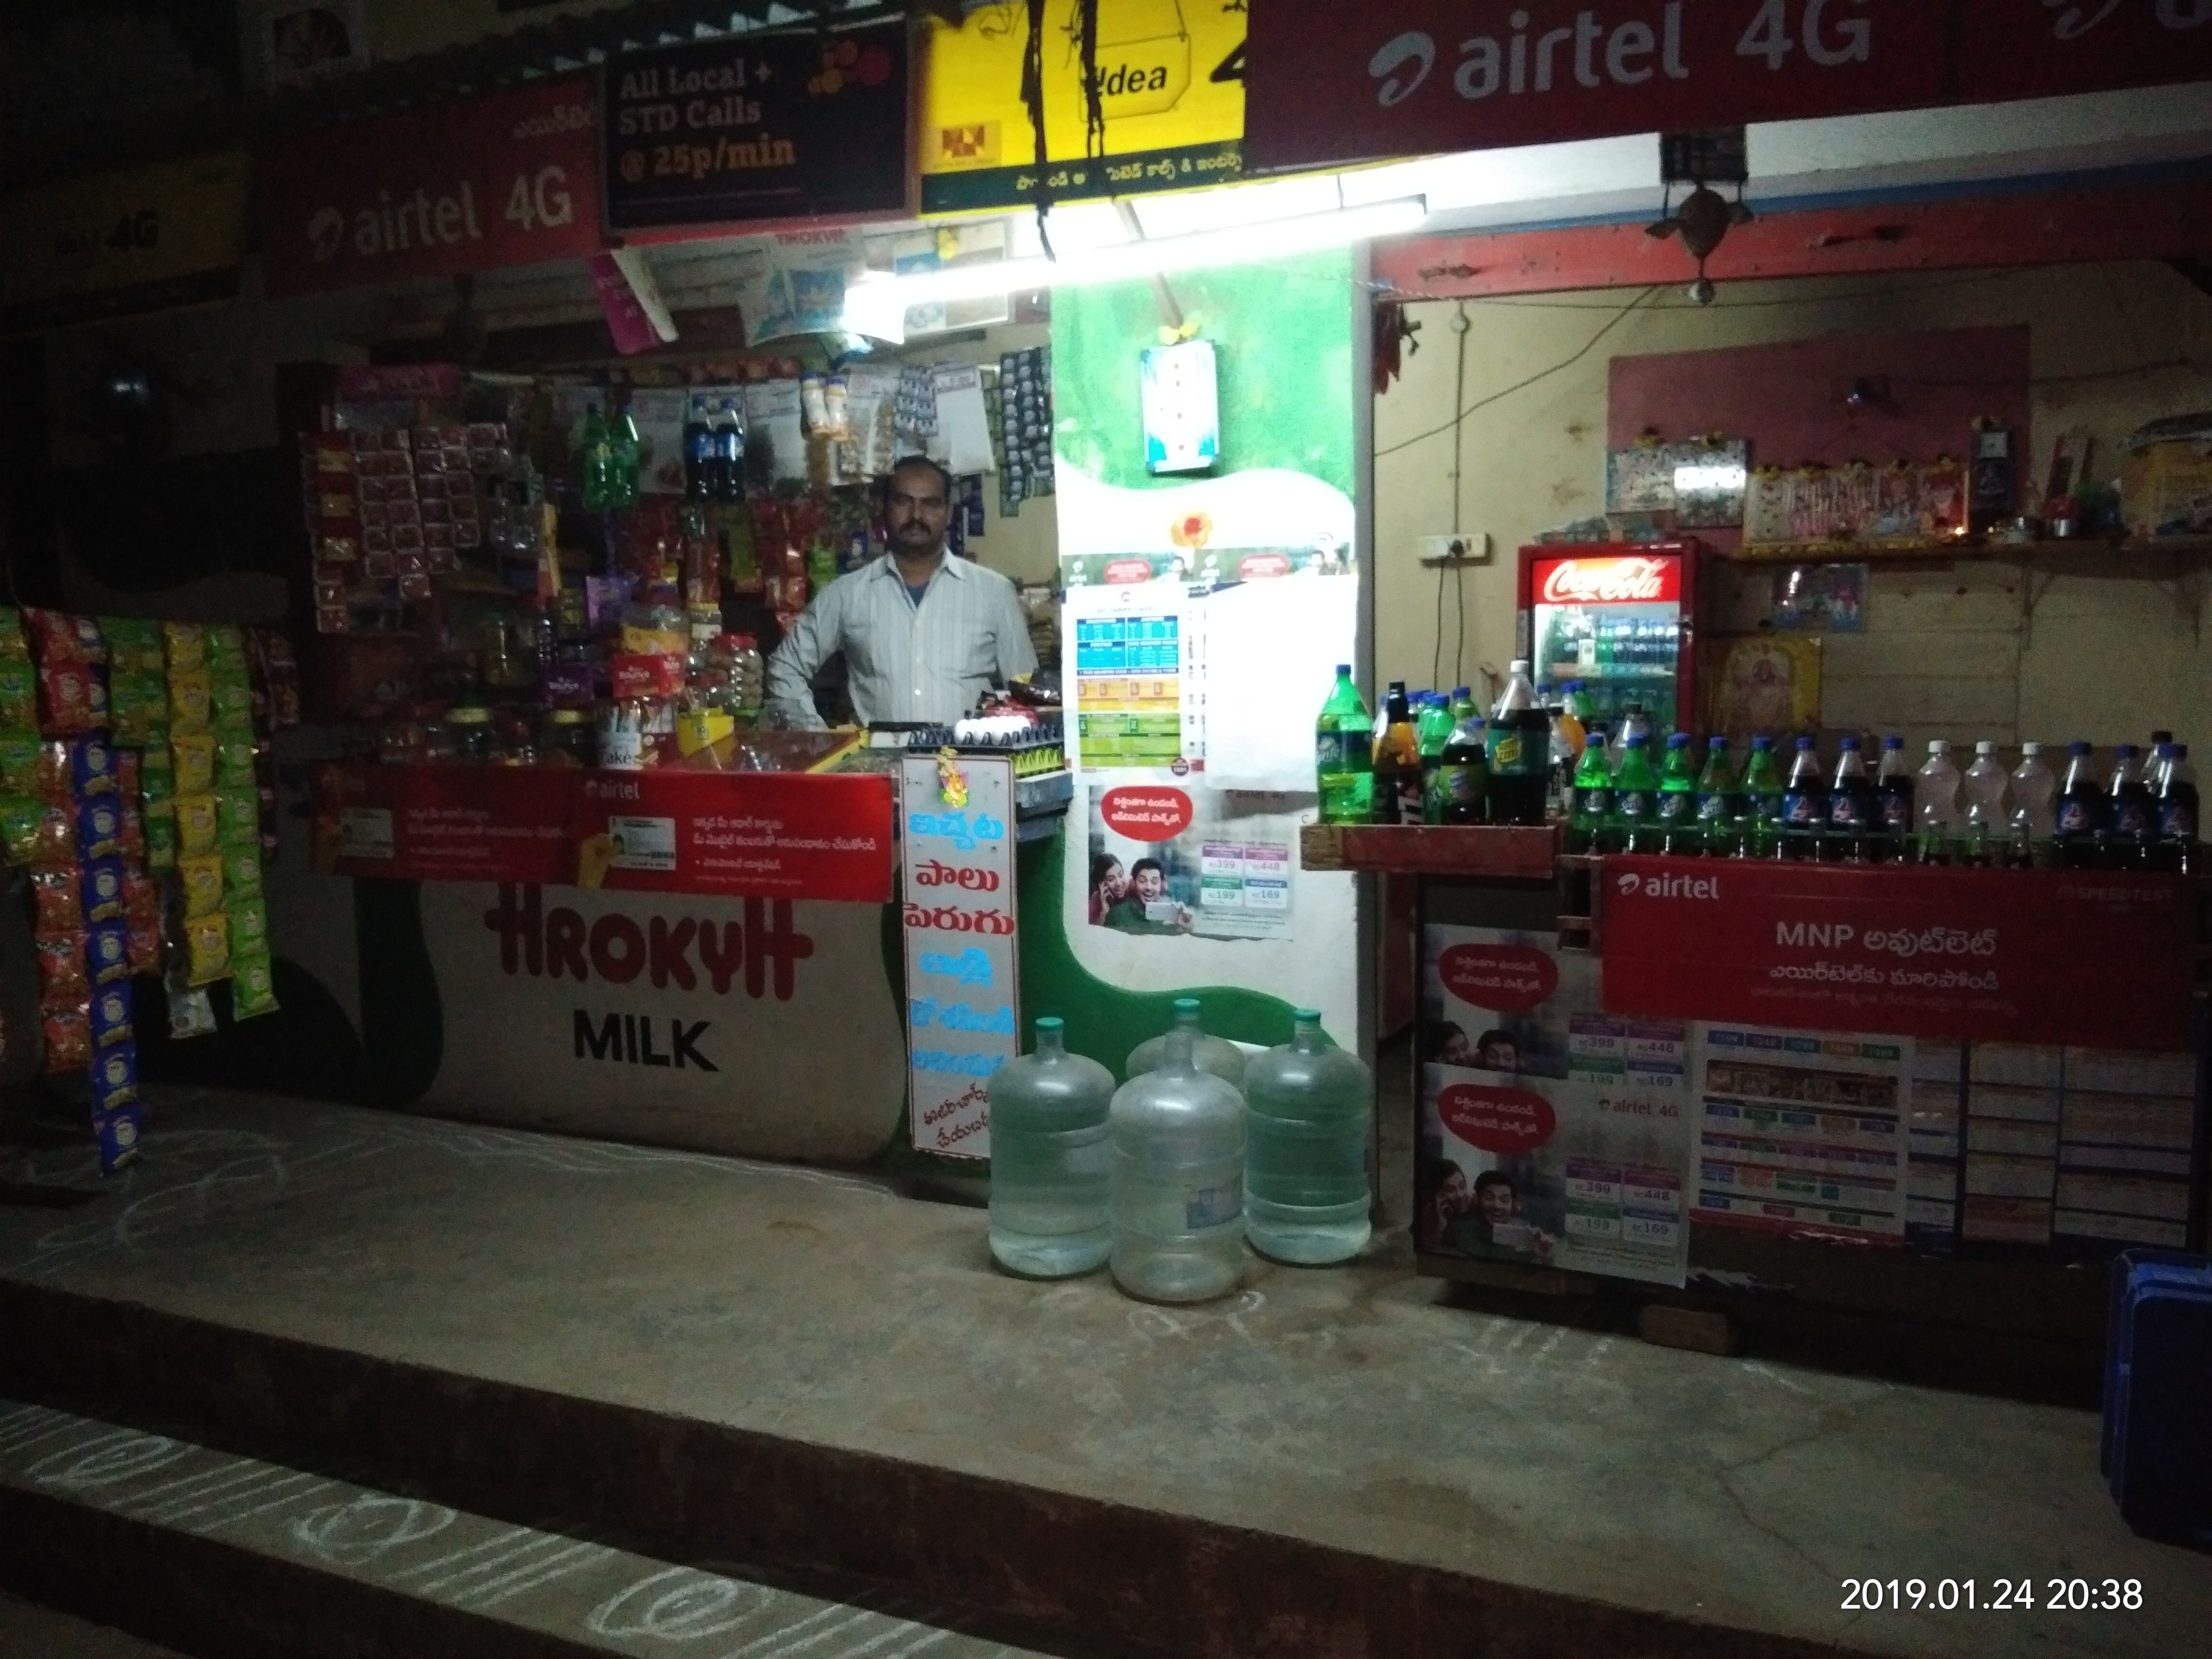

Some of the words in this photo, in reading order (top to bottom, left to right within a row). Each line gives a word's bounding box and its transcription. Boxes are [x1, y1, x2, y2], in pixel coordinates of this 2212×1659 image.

[1453, 2, 1689, 99] airtel
[1736, 0, 1872, 71] 4G
[621, 67, 660, 100] All
[669, 58, 748, 95] Local
[620, 102, 678, 135] STD
[686, 96, 762, 130] Calls
[653, 132, 796, 180] 25p/min
[355, 179, 483, 255] airtel
[505, 165, 574, 231] 4G
[600, 780, 640, 800] airtel
[915, 858, 1000, 892] పాలు
[1645, 872, 1719, 901] airtel
[903, 902, 1016, 936] పెరుగు
[1777, 921, 1854, 949] MNP
[574, 1008, 720, 1072] MILK
[1613, 1096, 1652, 1115] airtel
[1659, 1104, 1679, 1118] 4G
